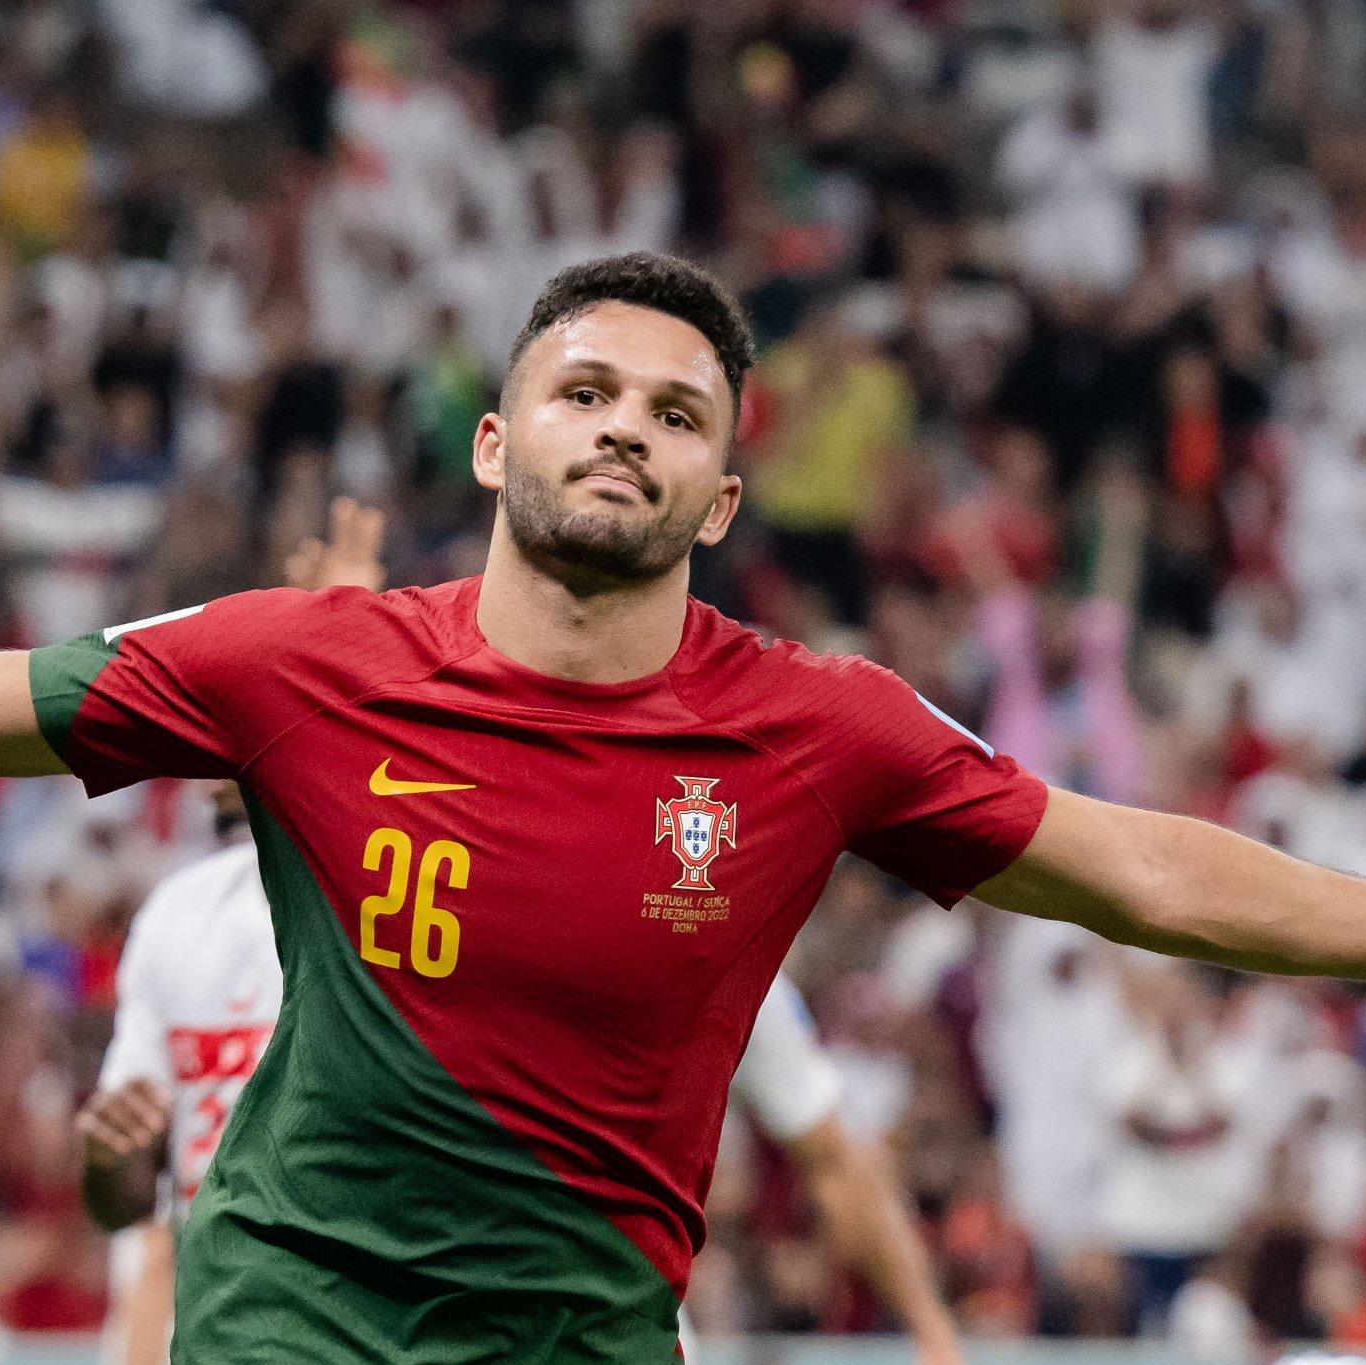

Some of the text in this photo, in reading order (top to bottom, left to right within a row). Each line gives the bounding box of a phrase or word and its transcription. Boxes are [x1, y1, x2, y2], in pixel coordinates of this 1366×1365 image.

[360, 827, 471, 978] 26
[643, 893, 694, 908] PORTUGAL
[649, 907, 661, 919] DE
[663, 908, 707, 921] DEZEMBRO
[708, 908, 731, 921] 2022
[672, 922, 698, 934] DOHA
